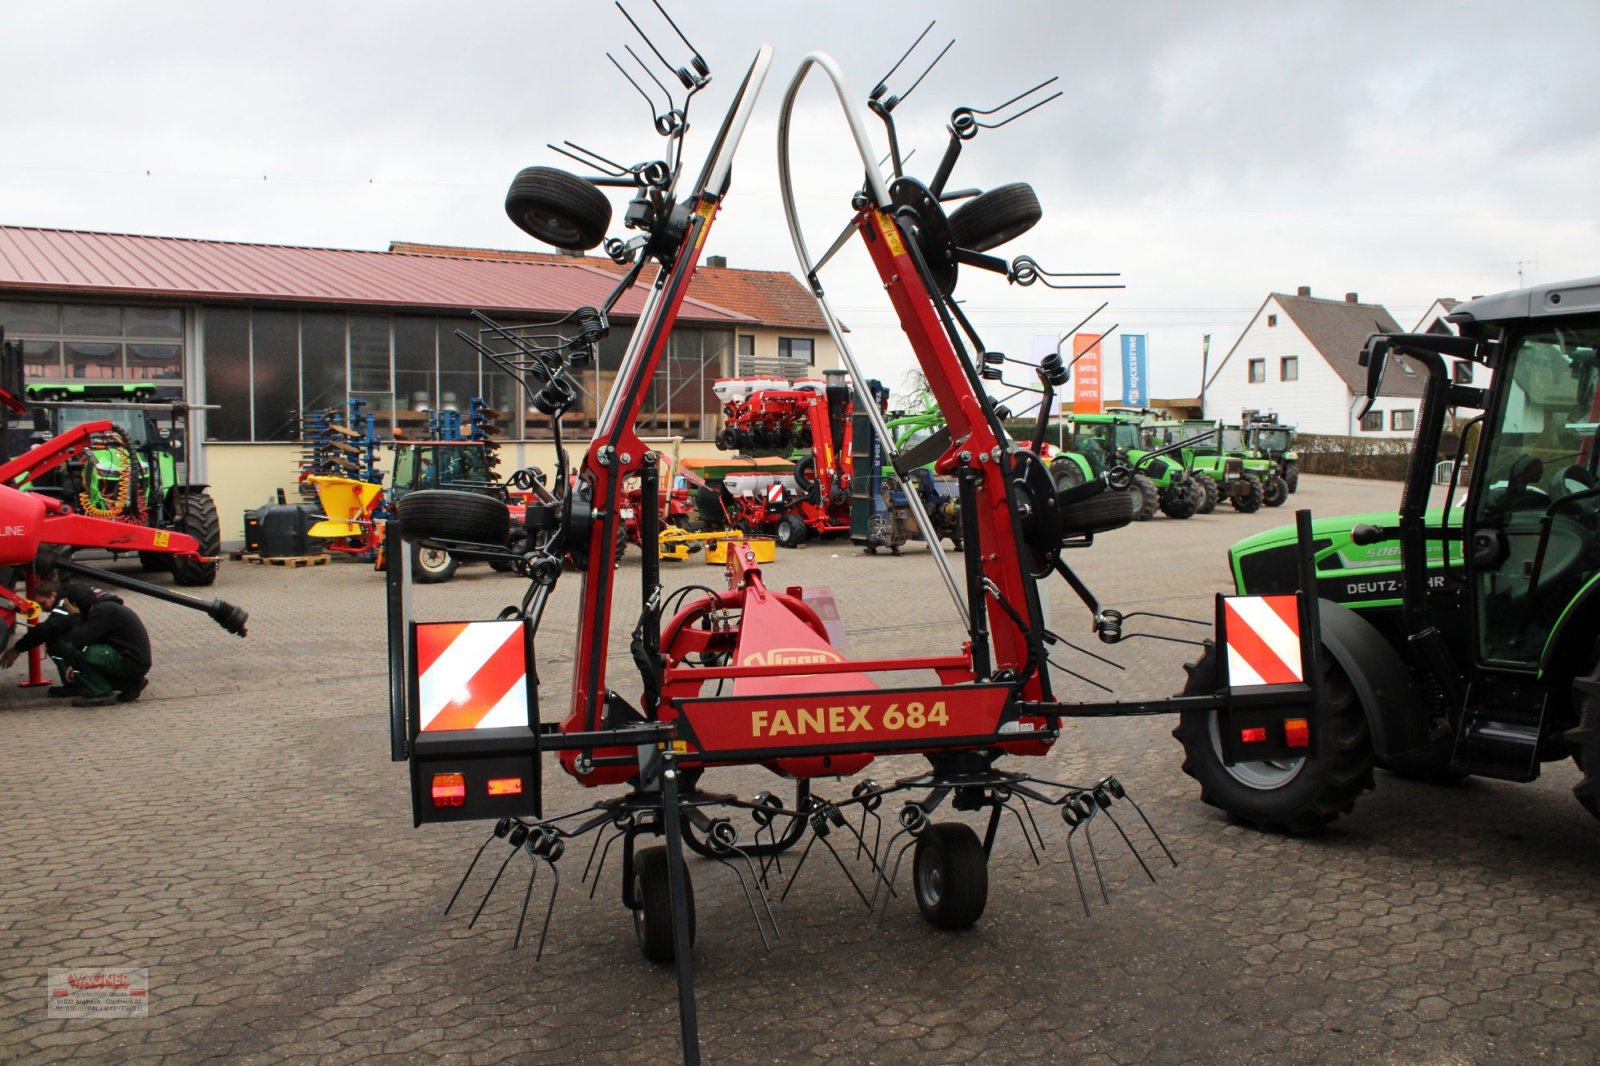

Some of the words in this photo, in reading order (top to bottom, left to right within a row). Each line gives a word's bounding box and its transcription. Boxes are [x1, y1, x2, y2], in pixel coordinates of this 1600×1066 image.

[1367, 546, 1401, 558] 508
[751, 704, 873, 737] FANEX
[882, 701, 949, 729] 684
